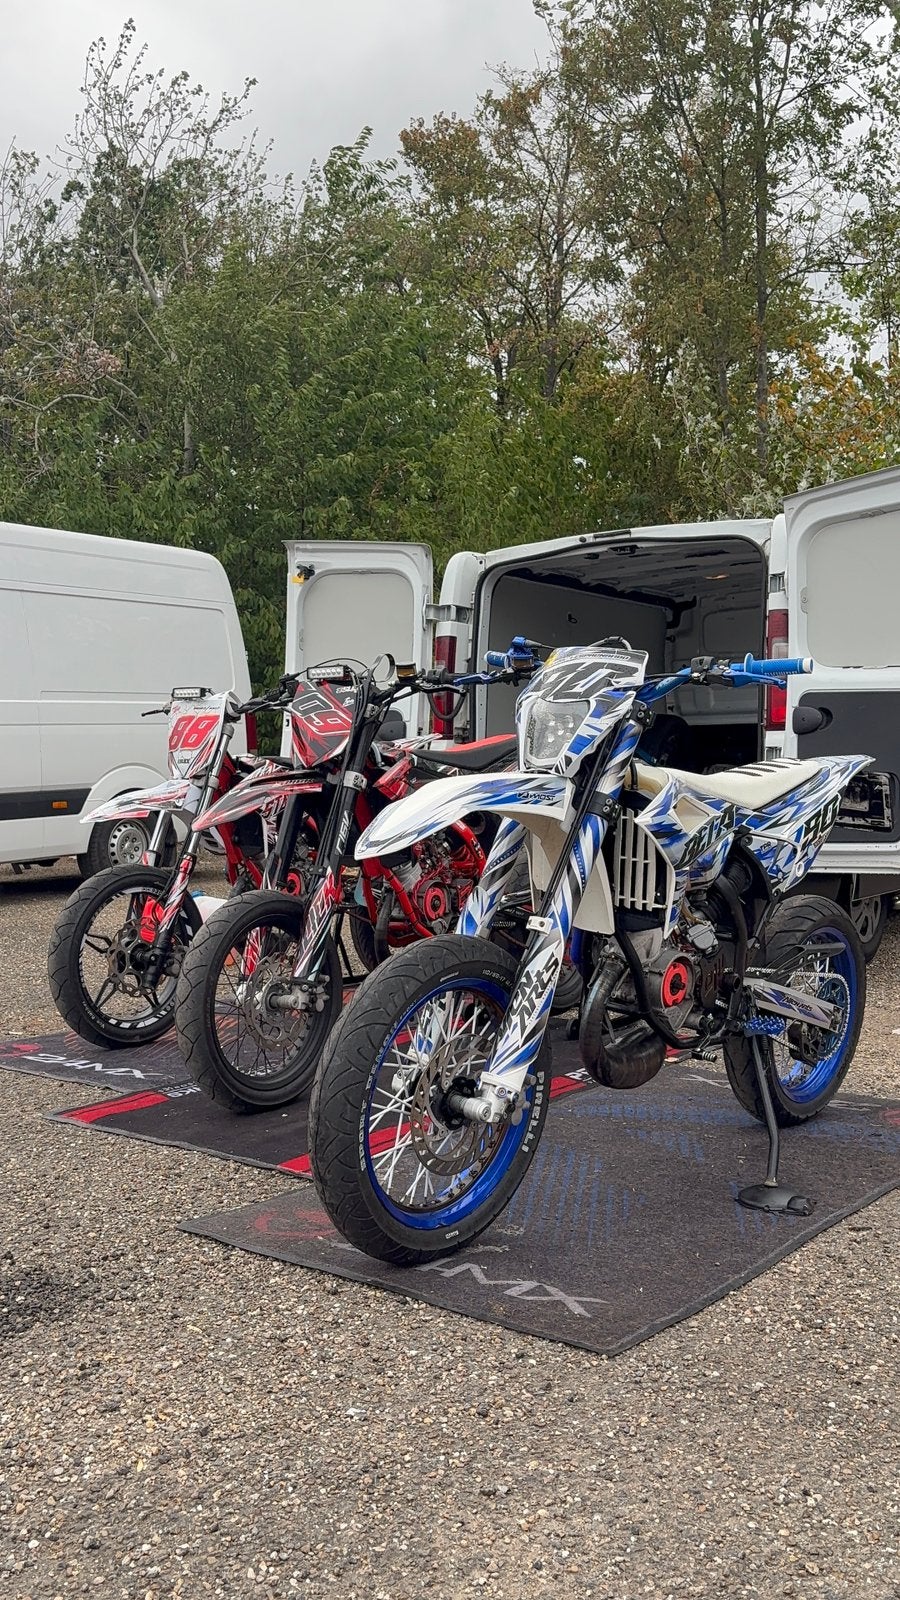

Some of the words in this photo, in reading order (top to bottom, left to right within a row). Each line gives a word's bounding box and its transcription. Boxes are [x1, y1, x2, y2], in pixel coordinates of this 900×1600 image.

[169, 714, 221, 752] 88
[357, 1099, 369, 1172] SPORT
[521, 1071, 545, 1153] PIRELLI
